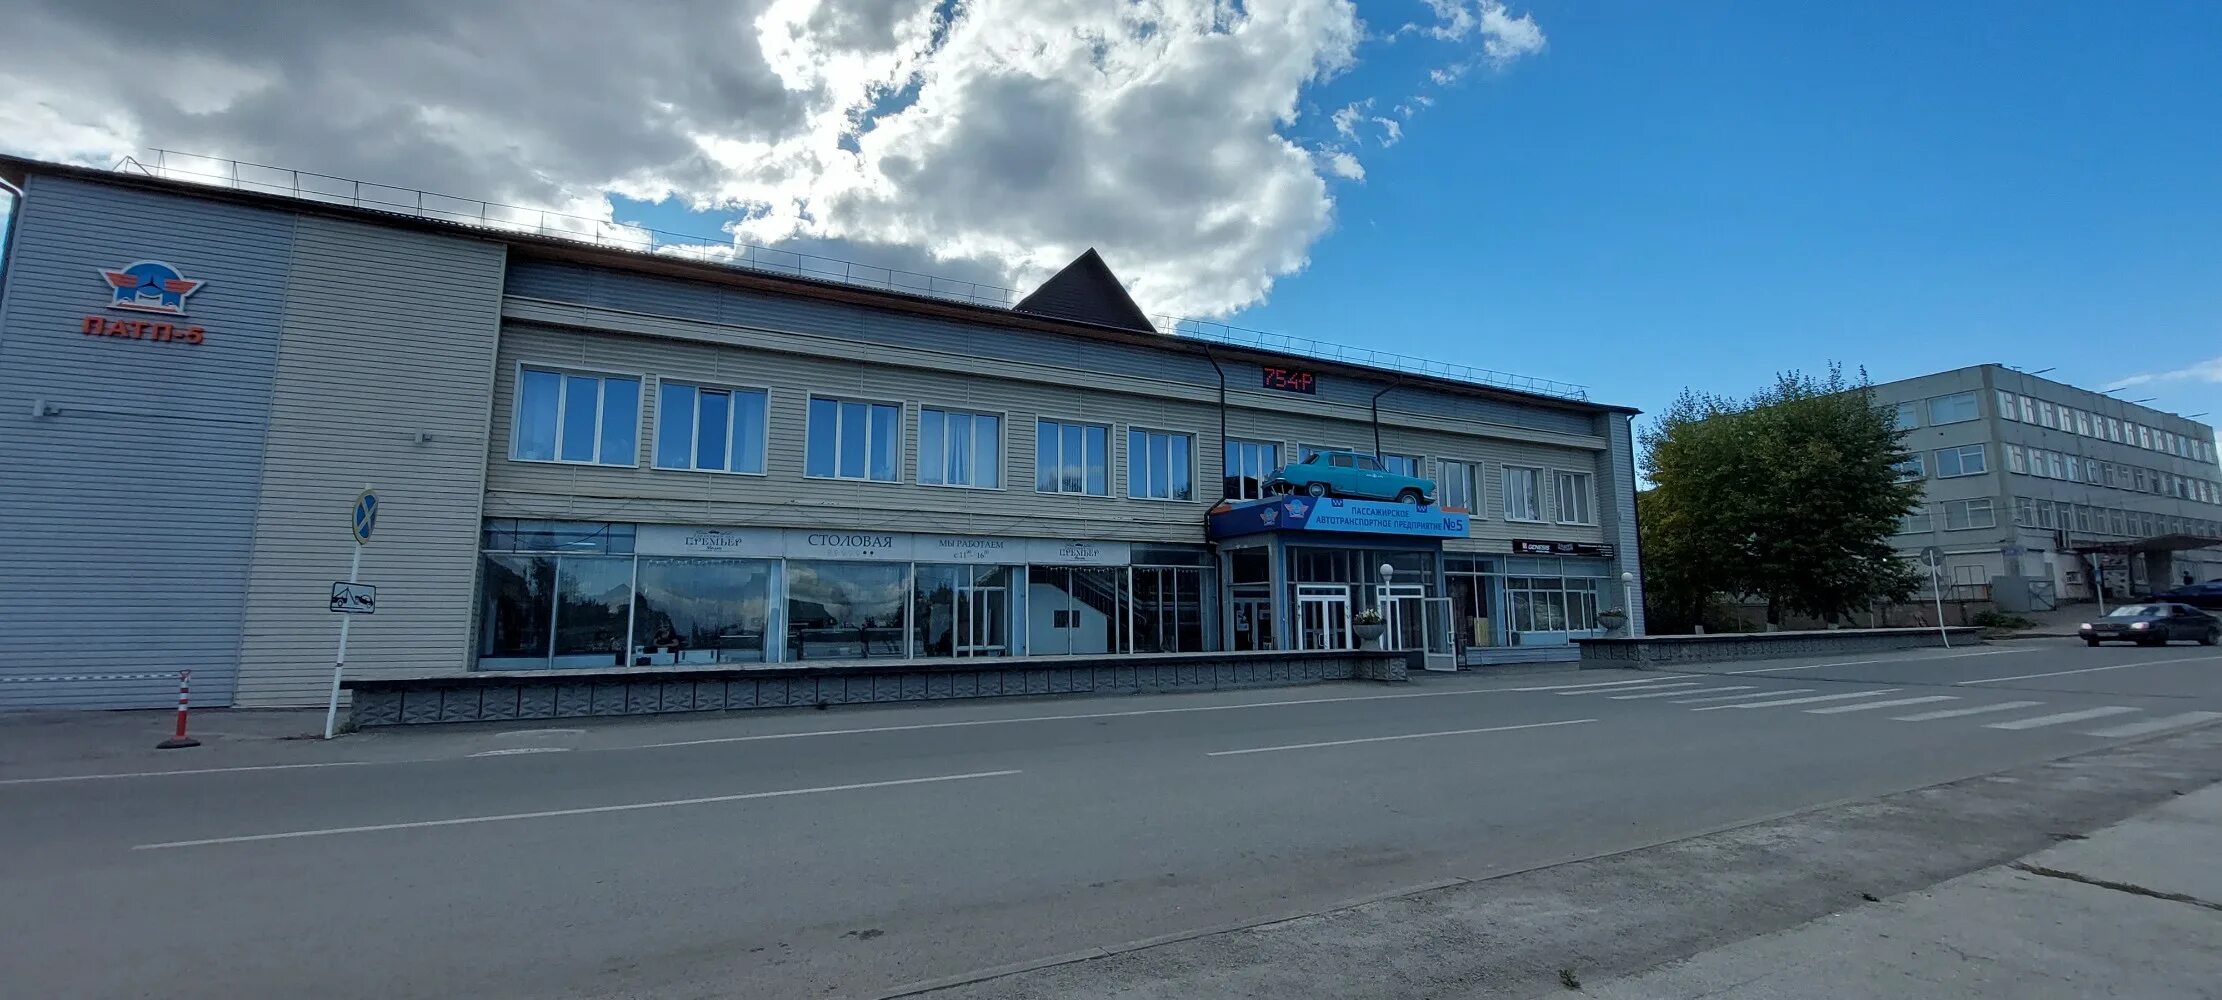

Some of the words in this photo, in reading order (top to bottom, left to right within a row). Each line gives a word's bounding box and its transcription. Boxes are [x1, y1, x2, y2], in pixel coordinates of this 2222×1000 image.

[82, 315, 205, 345] ПАТП-5
[1351, 506, 1410, 518] ПАССАЖИРСКОЕ
[1316, 516, 1391, 528] АВТОТРАНСПОРТНОЕ
[1393, 520, 1442, 531] ПРЕДПРИЯТИЕ
[808, 534, 893, 548] СТОЛОВАЯ
[939, 540, 955, 548] МЫ
[957, 540, 1004, 549] РАБОТАЕМ
